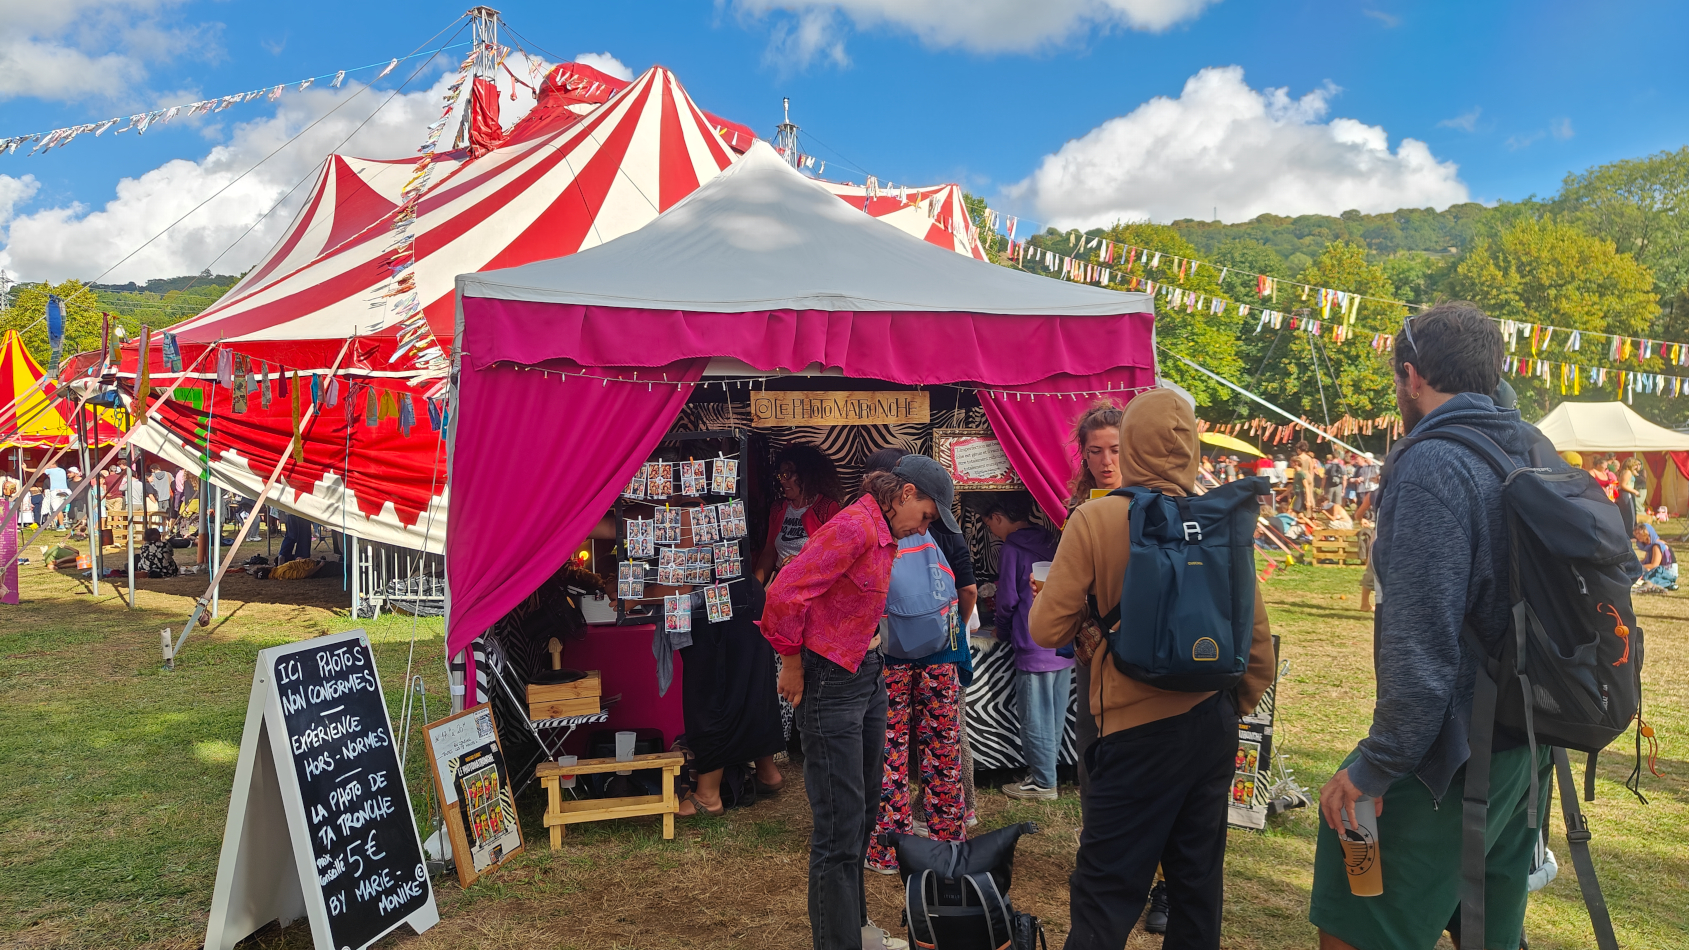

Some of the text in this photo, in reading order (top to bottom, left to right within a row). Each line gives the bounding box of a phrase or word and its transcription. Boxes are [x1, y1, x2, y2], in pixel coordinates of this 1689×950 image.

[316, 646, 365, 678] PHOTOS
[282, 669, 376, 716] NON CONFORMES
[311, 770, 388, 825] LA PHOTO DE
[318, 795, 395, 850] TA TRONCHE
[329, 889, 347, 917] BY
